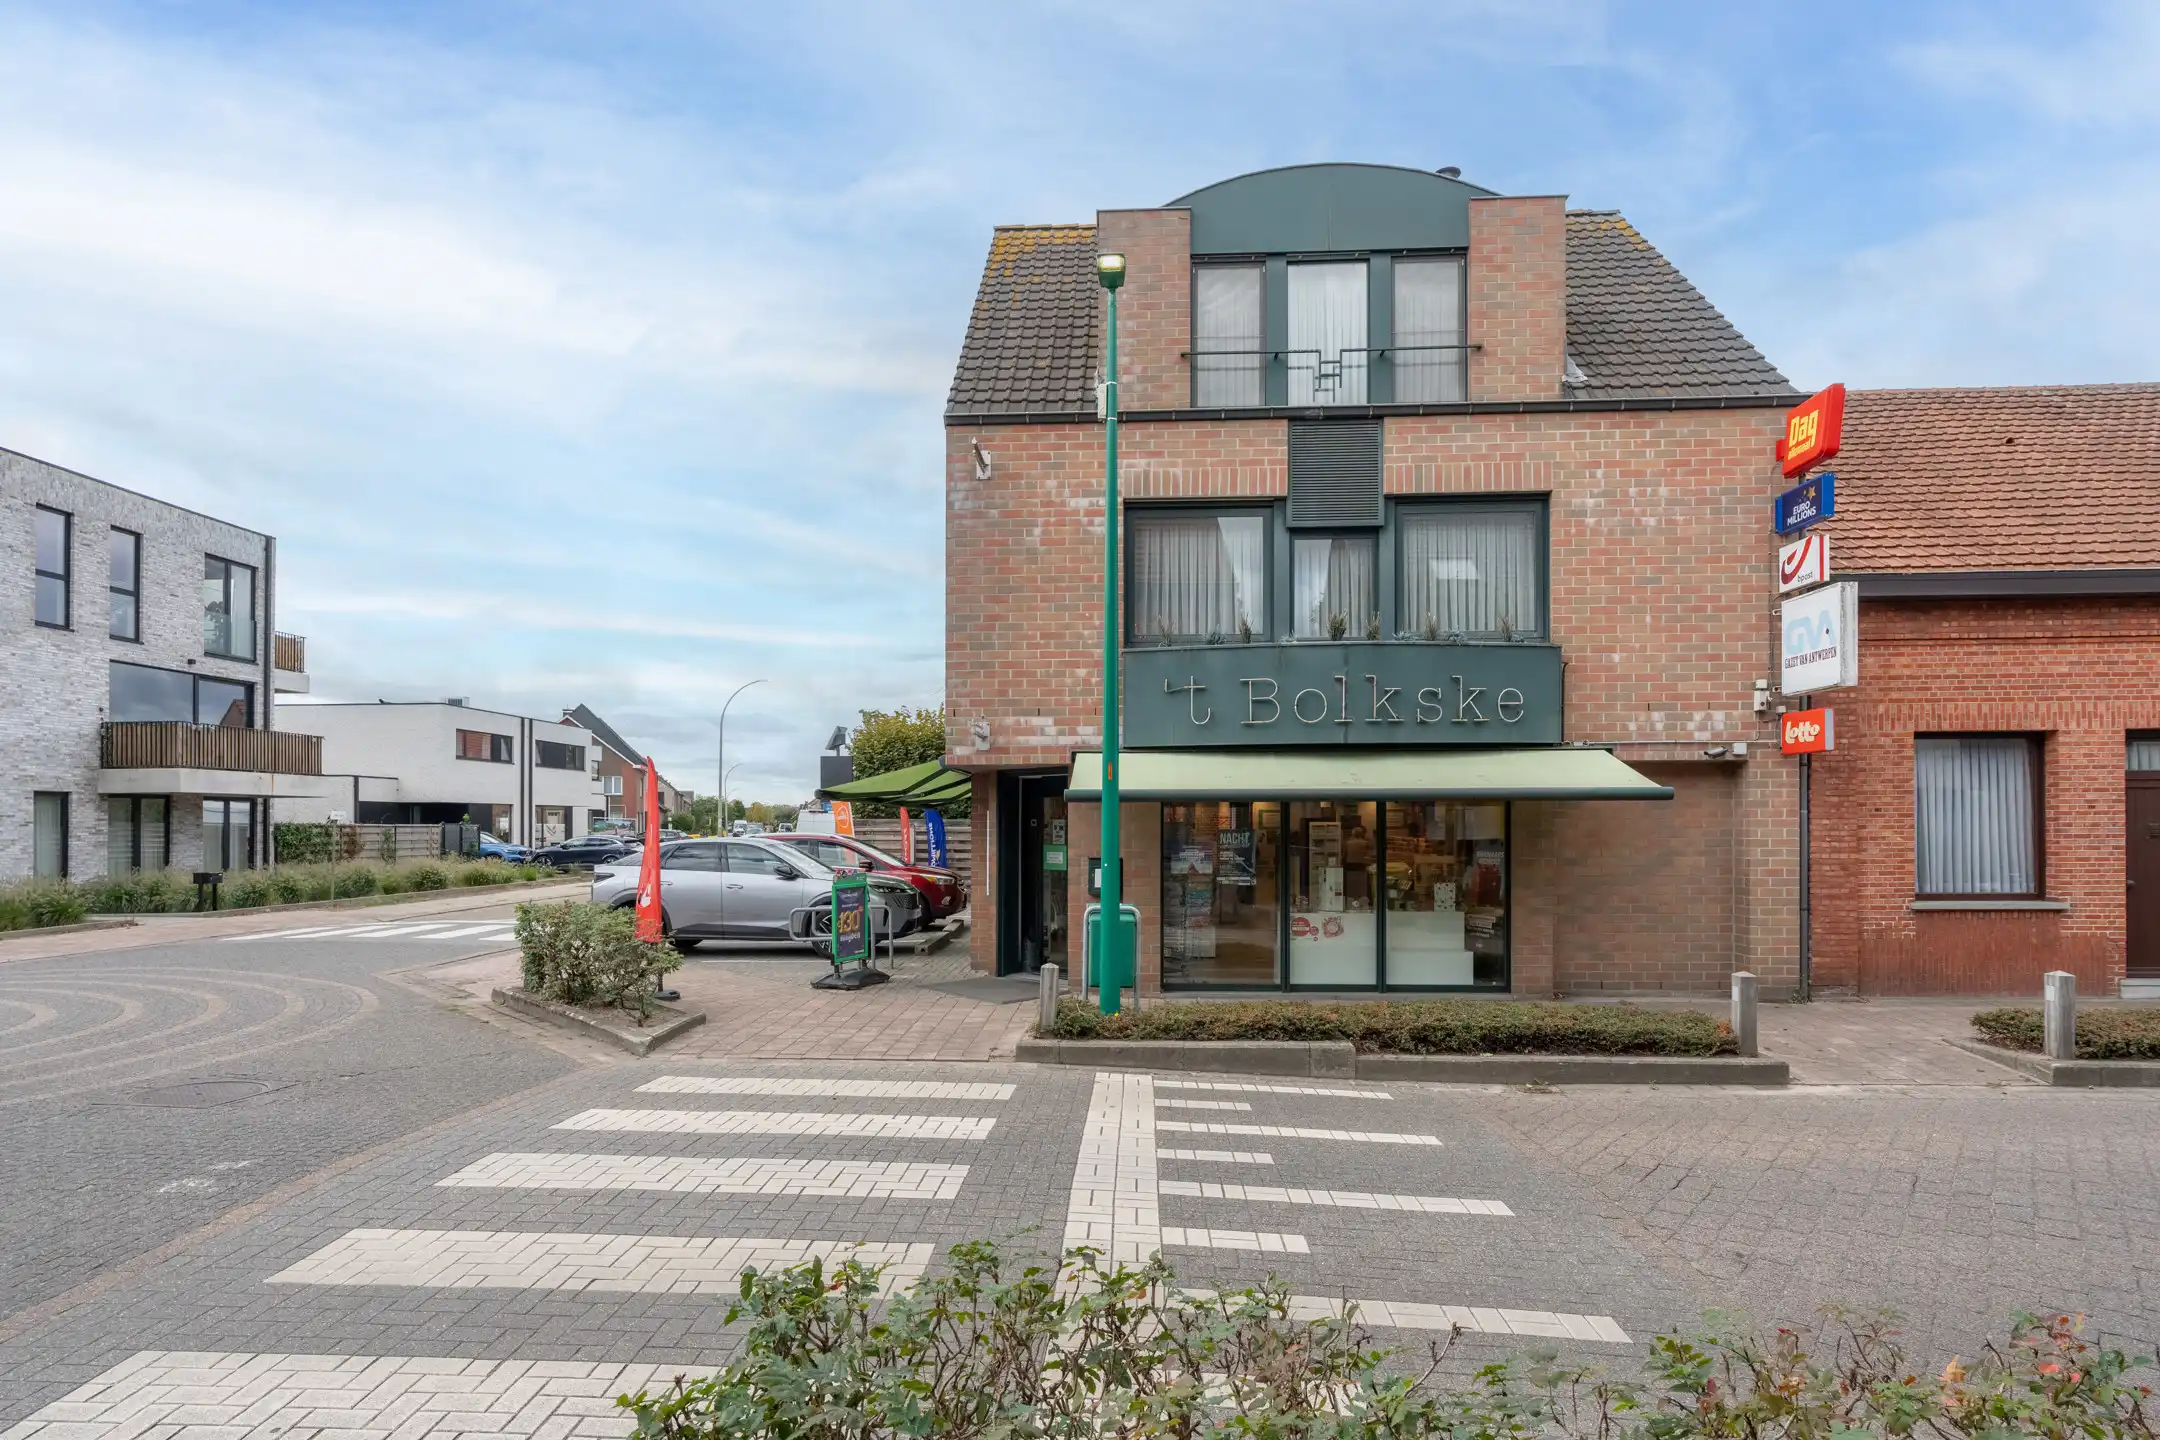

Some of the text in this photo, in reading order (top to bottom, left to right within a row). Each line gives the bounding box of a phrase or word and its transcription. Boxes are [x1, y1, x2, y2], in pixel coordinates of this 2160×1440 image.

[1789, 409, 1819, 448] Dag
[1787, 506, 1817, 526] MILLIONS
[1793, 501, 1811, 516] EURO
[1797, 571, 1813, 583] bpost
[1785, 646, 1837, 669] GAZET VAN ANTWERPEN
[1239, 674, 1524, 723] Bolkske
[1219, 832, 1250, 847] NACHT
